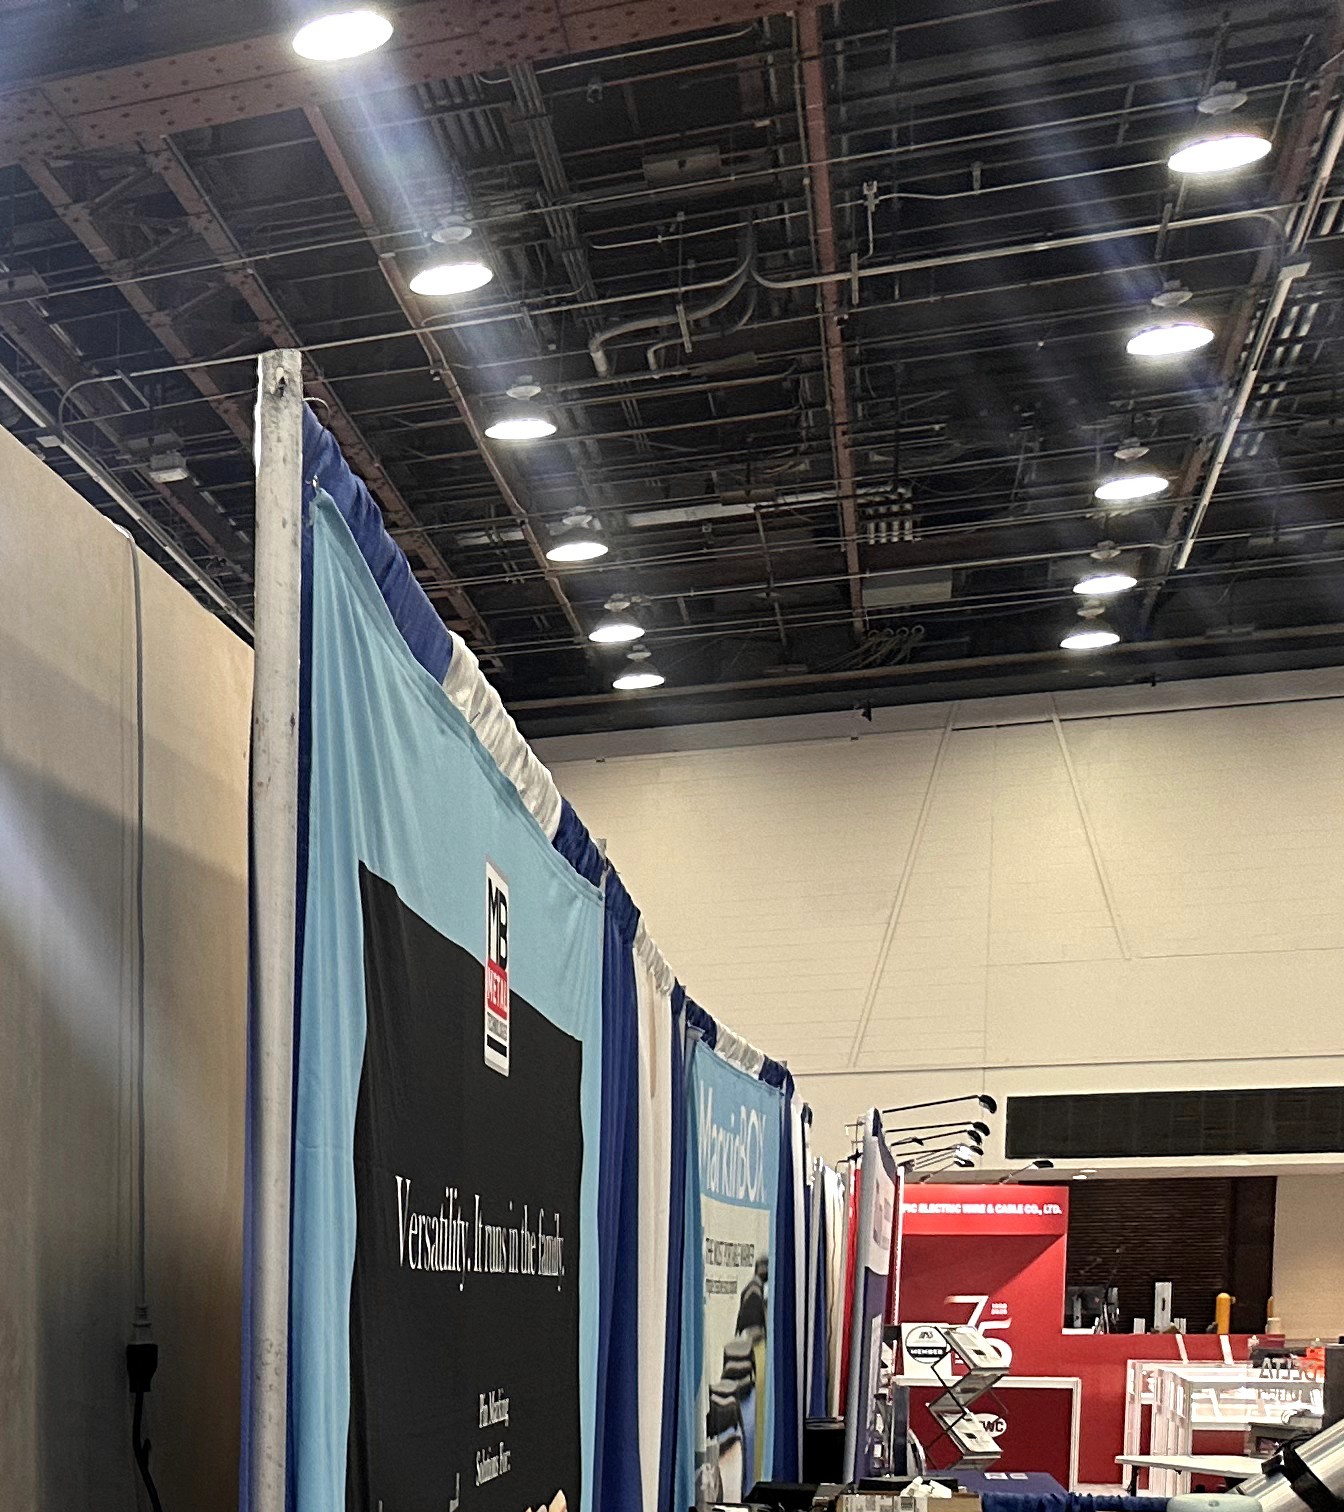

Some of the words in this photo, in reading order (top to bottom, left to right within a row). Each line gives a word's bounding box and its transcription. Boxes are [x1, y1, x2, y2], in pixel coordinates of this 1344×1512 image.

[698, 1080, 767, 1203] MarkinBOX
[395, 1175, 471, 1291] Versatility.
[521, 1204, 537, 1275] the
